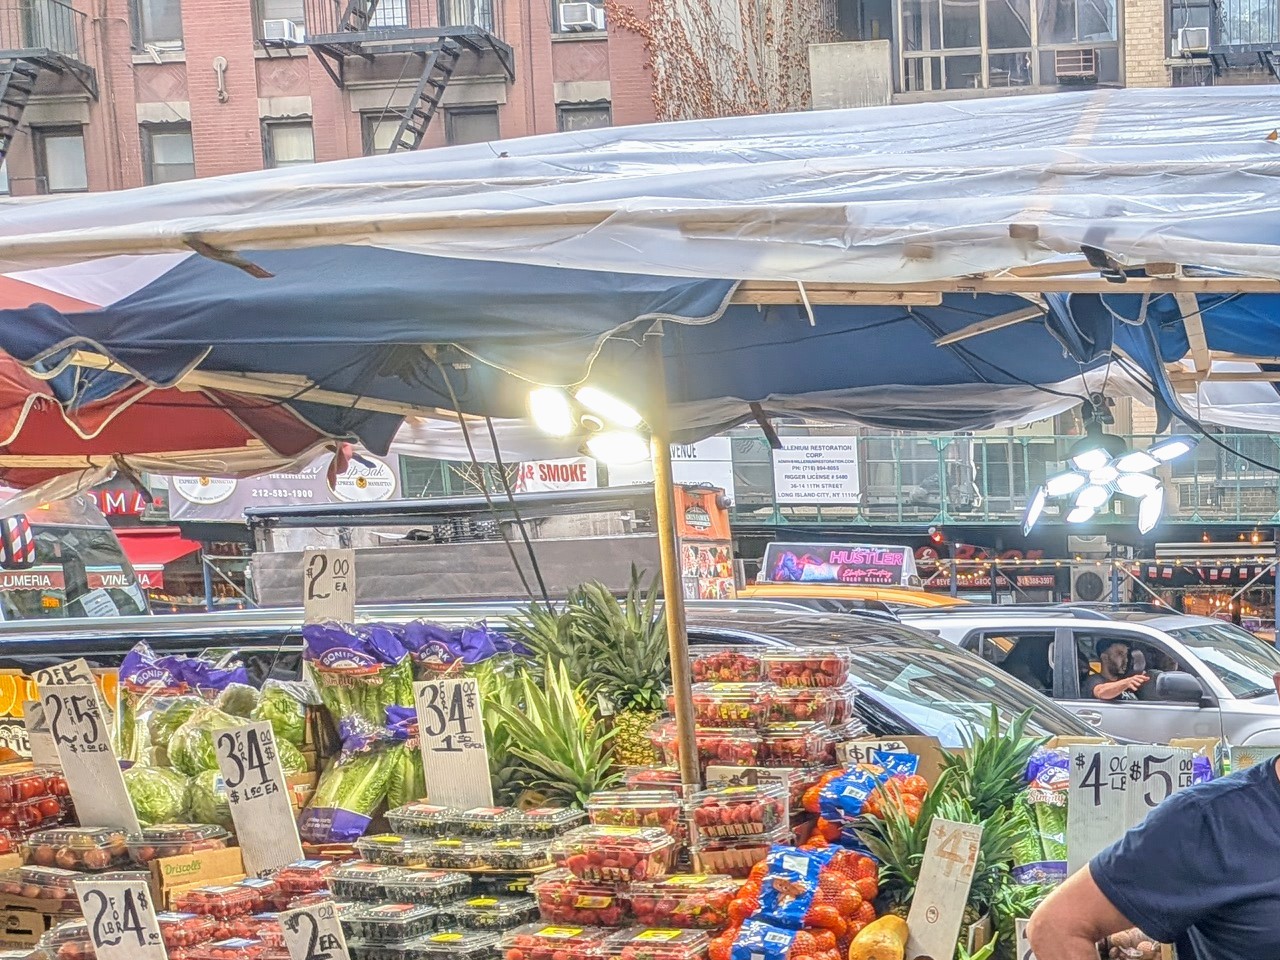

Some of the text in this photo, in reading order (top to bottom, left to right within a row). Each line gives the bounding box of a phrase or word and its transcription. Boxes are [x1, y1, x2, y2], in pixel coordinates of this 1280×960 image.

[525, 463, 588, 482] & SMOKE
[251, 489, 313, 498] 212-583-1900
[829, 550, 904, 566] HUSTLER
[308, 554, 331, 600] 2
[335, 581, 348, 593] EA
[322, 651, 368, 667] BONIPAK
[137, 666, 174, 686] BONIPAK
[420, 683, 447, 736] 3
[448, 683, 474, 736] 4
[98, 744, 109, 753] EA
[218, 733, 245, 788] 3
[247, 728, 274, 785] 4
[265, 782, 279, 795] EA
[1078, 751, 1109, 807] 4
[1142, 754, 1175, 808] 5
[1178, 774, 1193, 788] LB
[164, 859, 202, 876] Driscoll's
[83, 888, 122, 949] 2
[122, 887, 147, 948] 4
[319, 932, 343, 952] EA
